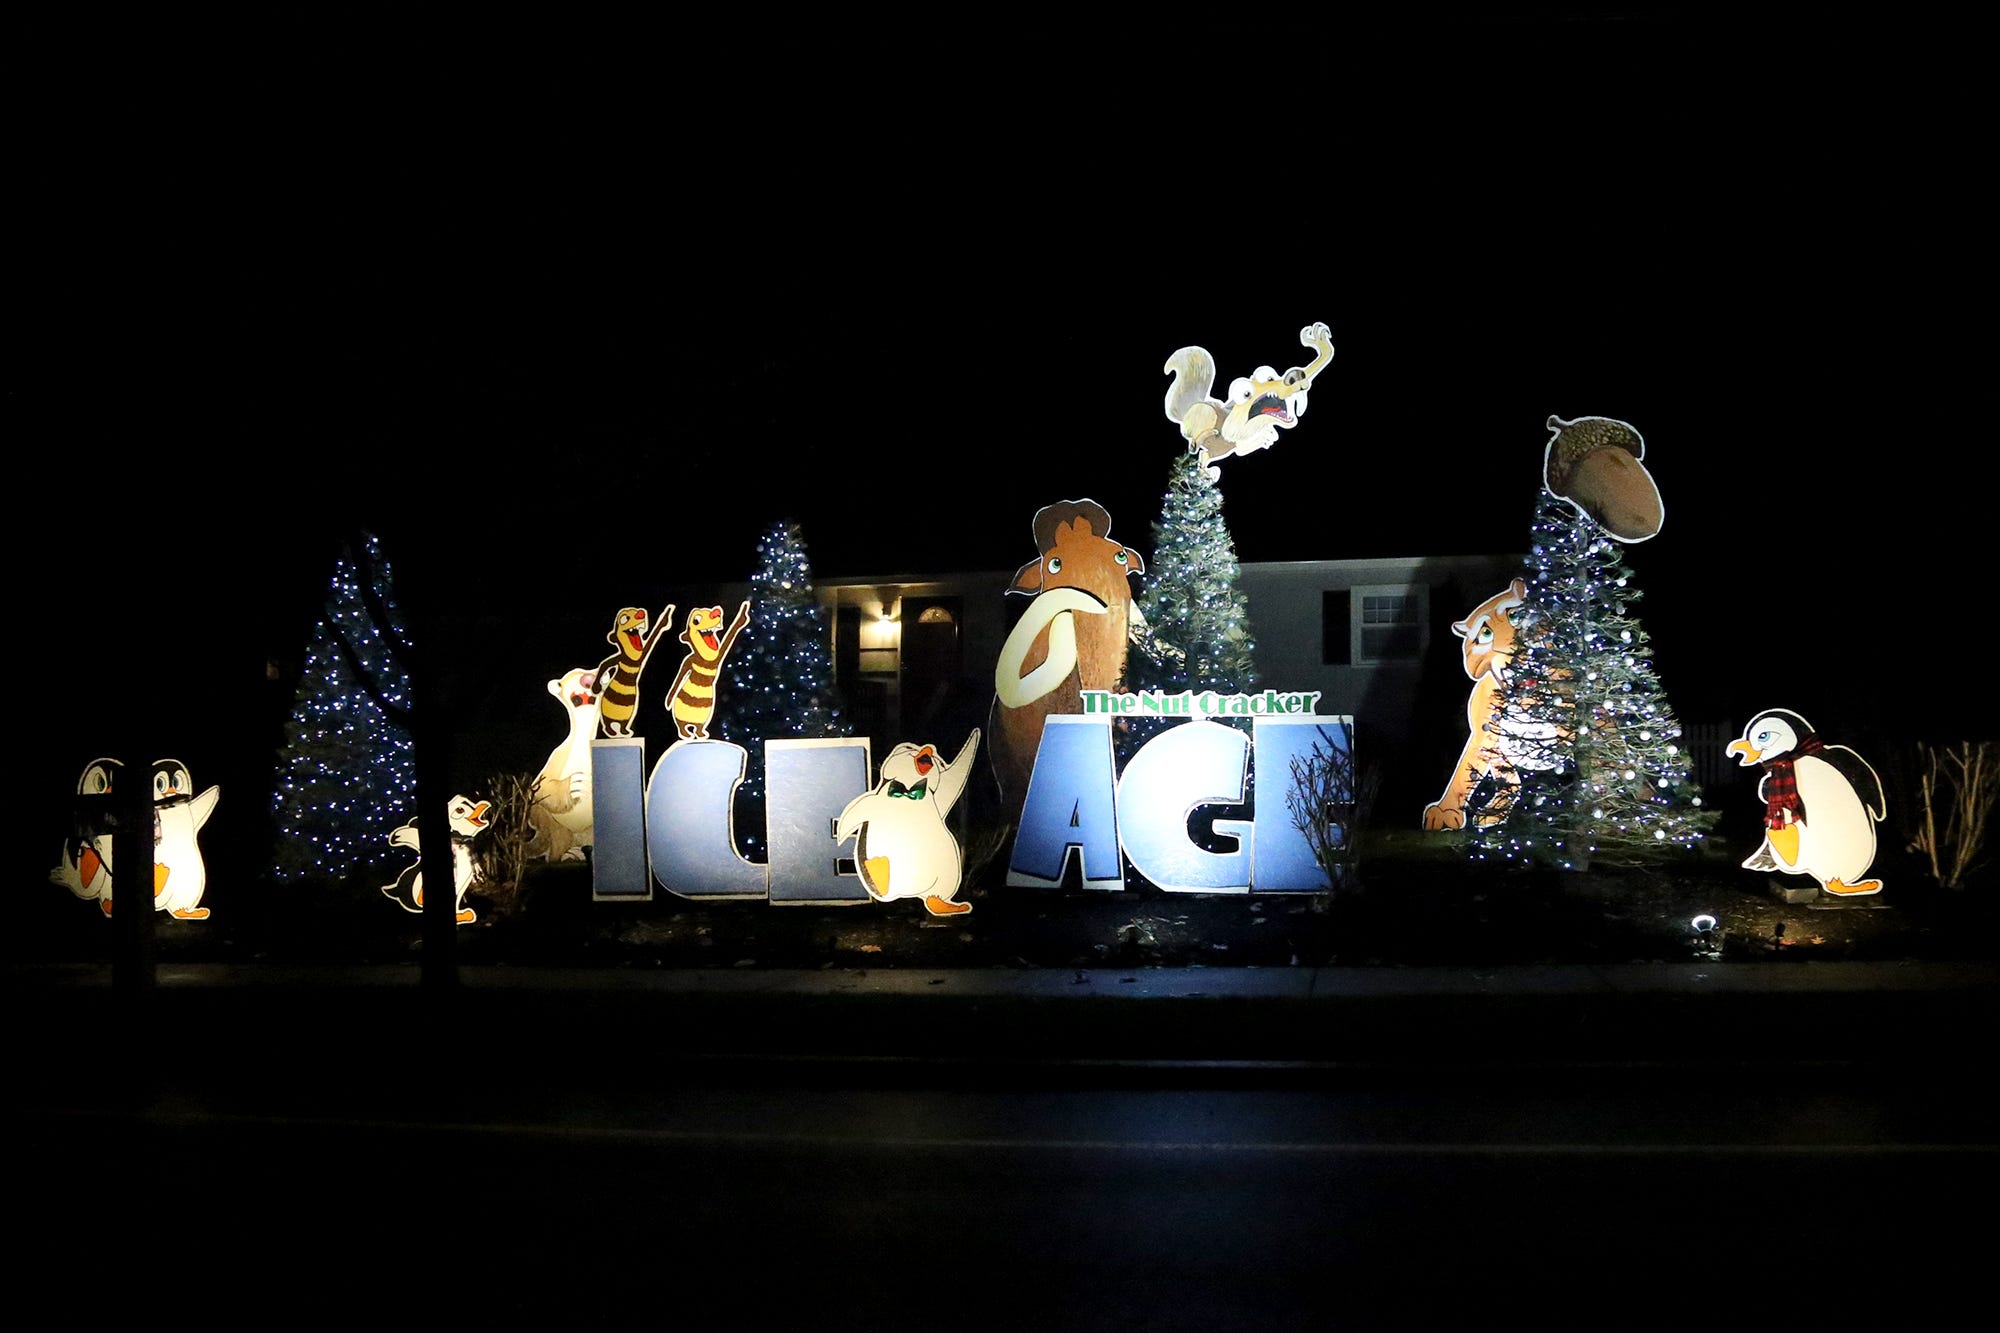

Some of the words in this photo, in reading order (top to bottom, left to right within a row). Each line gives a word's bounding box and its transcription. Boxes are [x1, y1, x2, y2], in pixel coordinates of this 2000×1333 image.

[1082, 691, 1136, 714] The
[1141, 690, 1192, 715] Nut
[1199, 690, 1319, 715] Cracker
[590, 737, 873, 907] ICE
[1006, 714, 1354, 895] AGE
